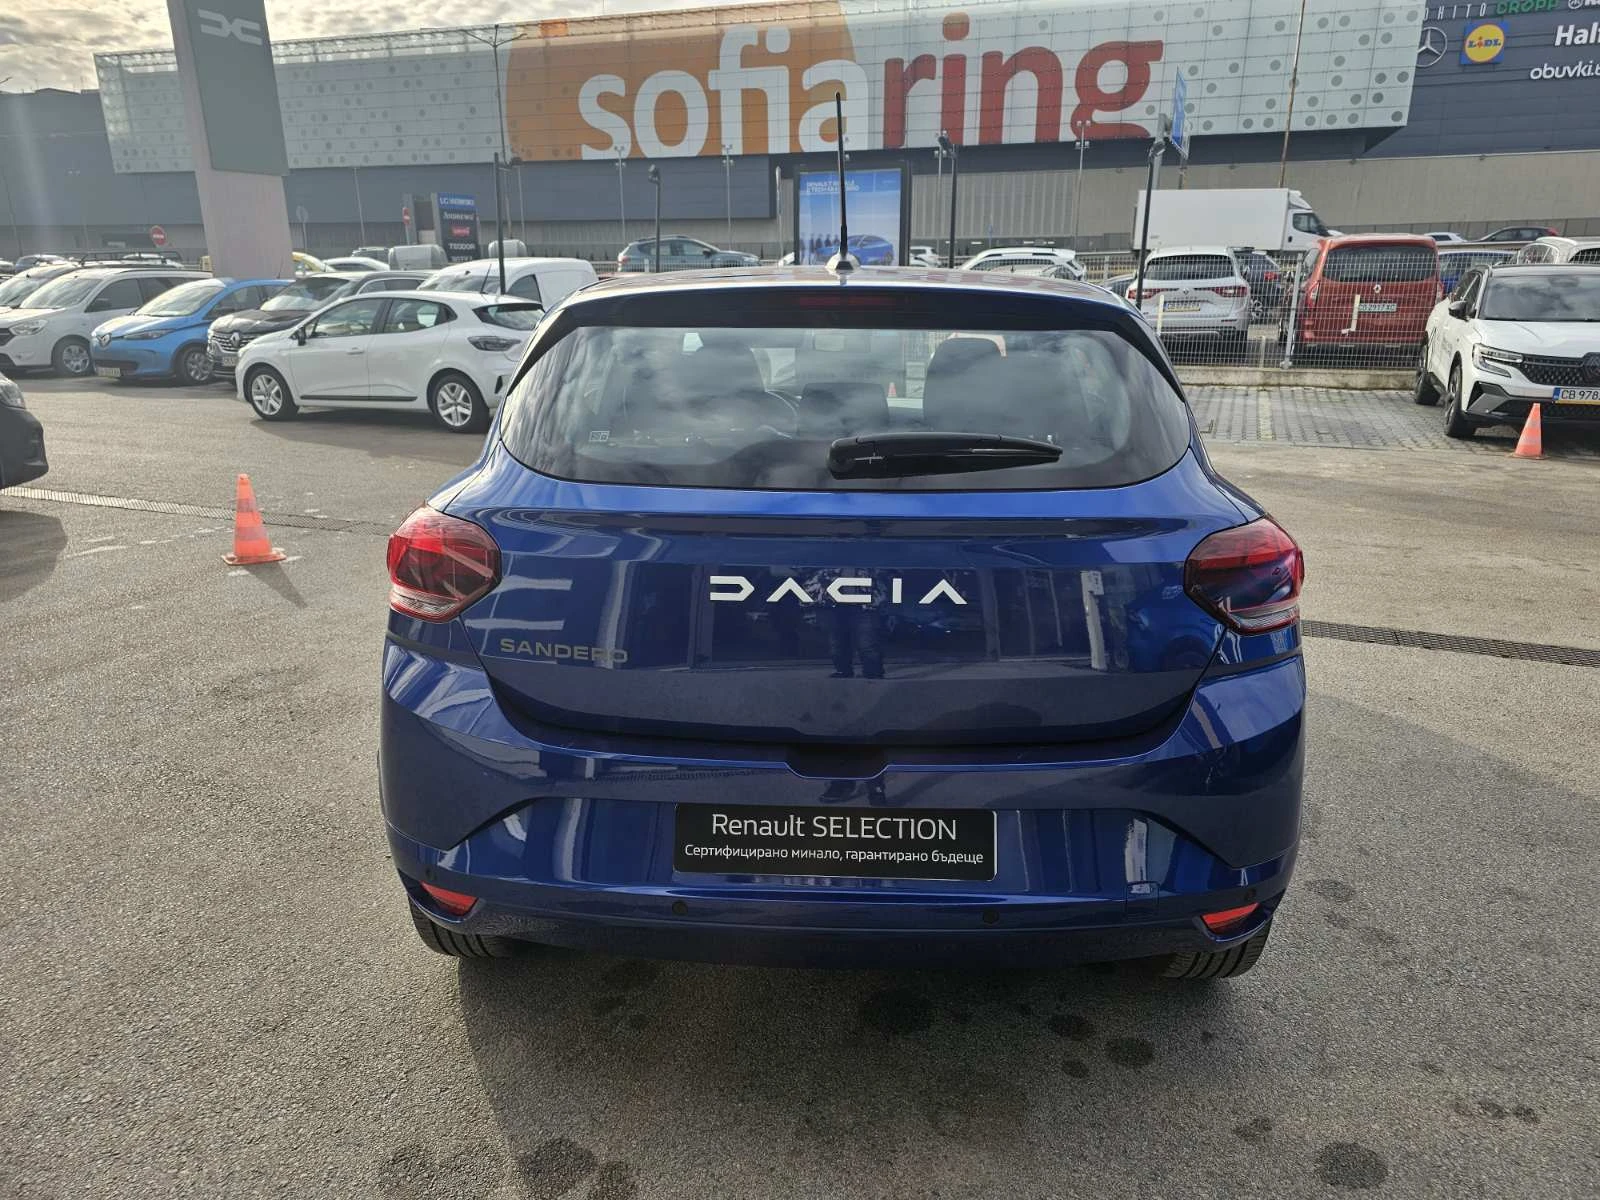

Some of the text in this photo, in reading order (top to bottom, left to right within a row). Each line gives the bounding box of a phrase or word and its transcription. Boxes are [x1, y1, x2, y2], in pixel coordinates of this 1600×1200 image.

[1561, 389, 1576, 400] CB
[1579, 390, 1600, 401] 978
[709, 575, 968, 605] DACIA
[500, 637, 628, 664] SANDERO
[711, 813, 957, 841] Renault SELECTION
[684, 844, 984, 865] Сертифицирано минало, гарантирано бъдеще
